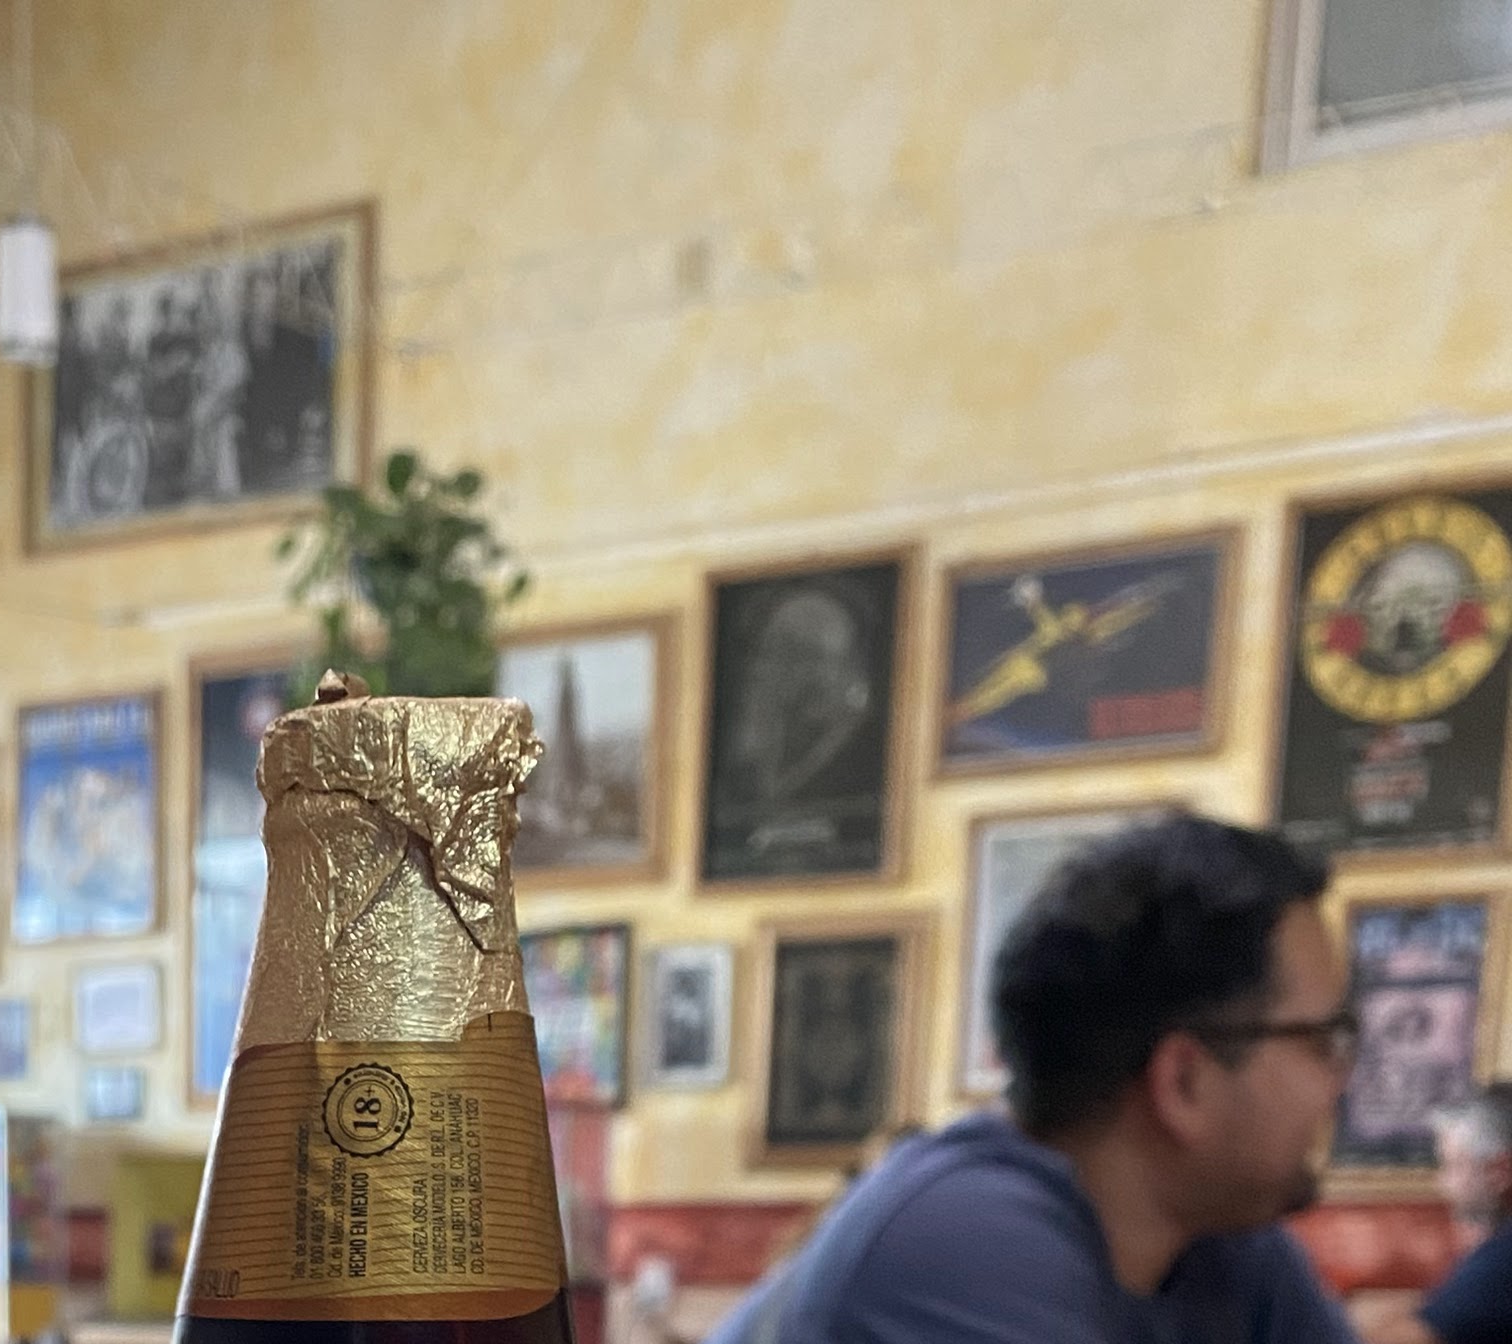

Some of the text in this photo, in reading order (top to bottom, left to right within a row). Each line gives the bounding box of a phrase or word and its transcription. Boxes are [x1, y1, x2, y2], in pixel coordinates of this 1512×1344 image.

[350, 1221, 368, 1236] EN
[412, 1178, 428, 1274] CERVEZA OSCURA
[450, 1196, 466, 1245] ALBERTO
[348, 1239, 367, 1278] HECHO
[452, 1247, 467, 1274] LAGO
[470, 1240, 484, 1254] DE
